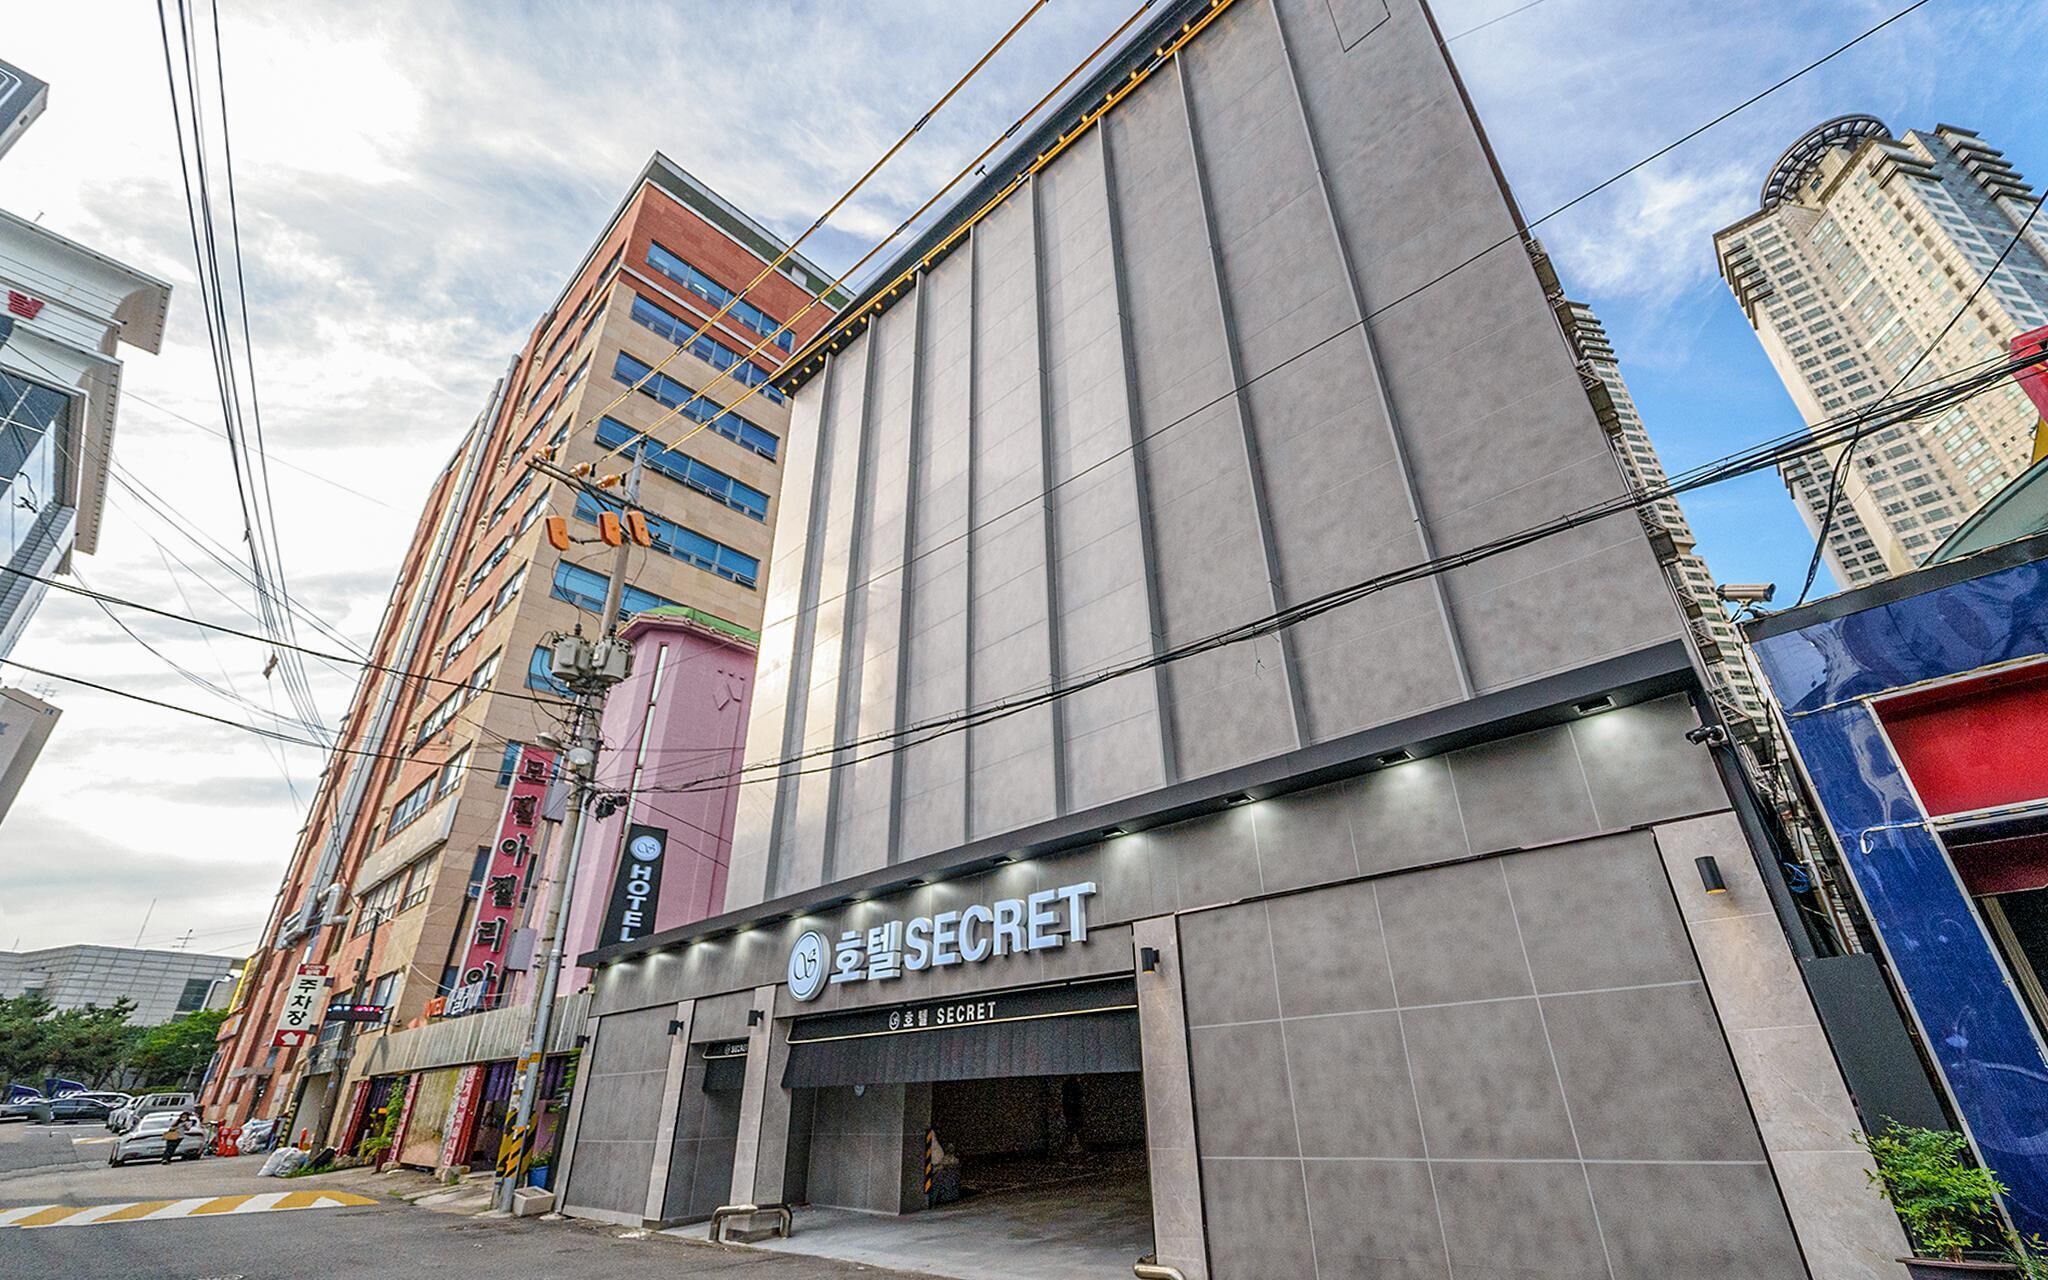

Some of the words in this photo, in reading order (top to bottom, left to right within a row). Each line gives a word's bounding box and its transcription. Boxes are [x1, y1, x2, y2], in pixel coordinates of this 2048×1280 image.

[620, 863, 652, 943] HOTEL
[830, 919, 903, 985] 호텔
[903, 881, 1097, 971] SECRET
[287, 978, 319, 1026] 주차장
[936, 1001, 996, 1025] SECRET
